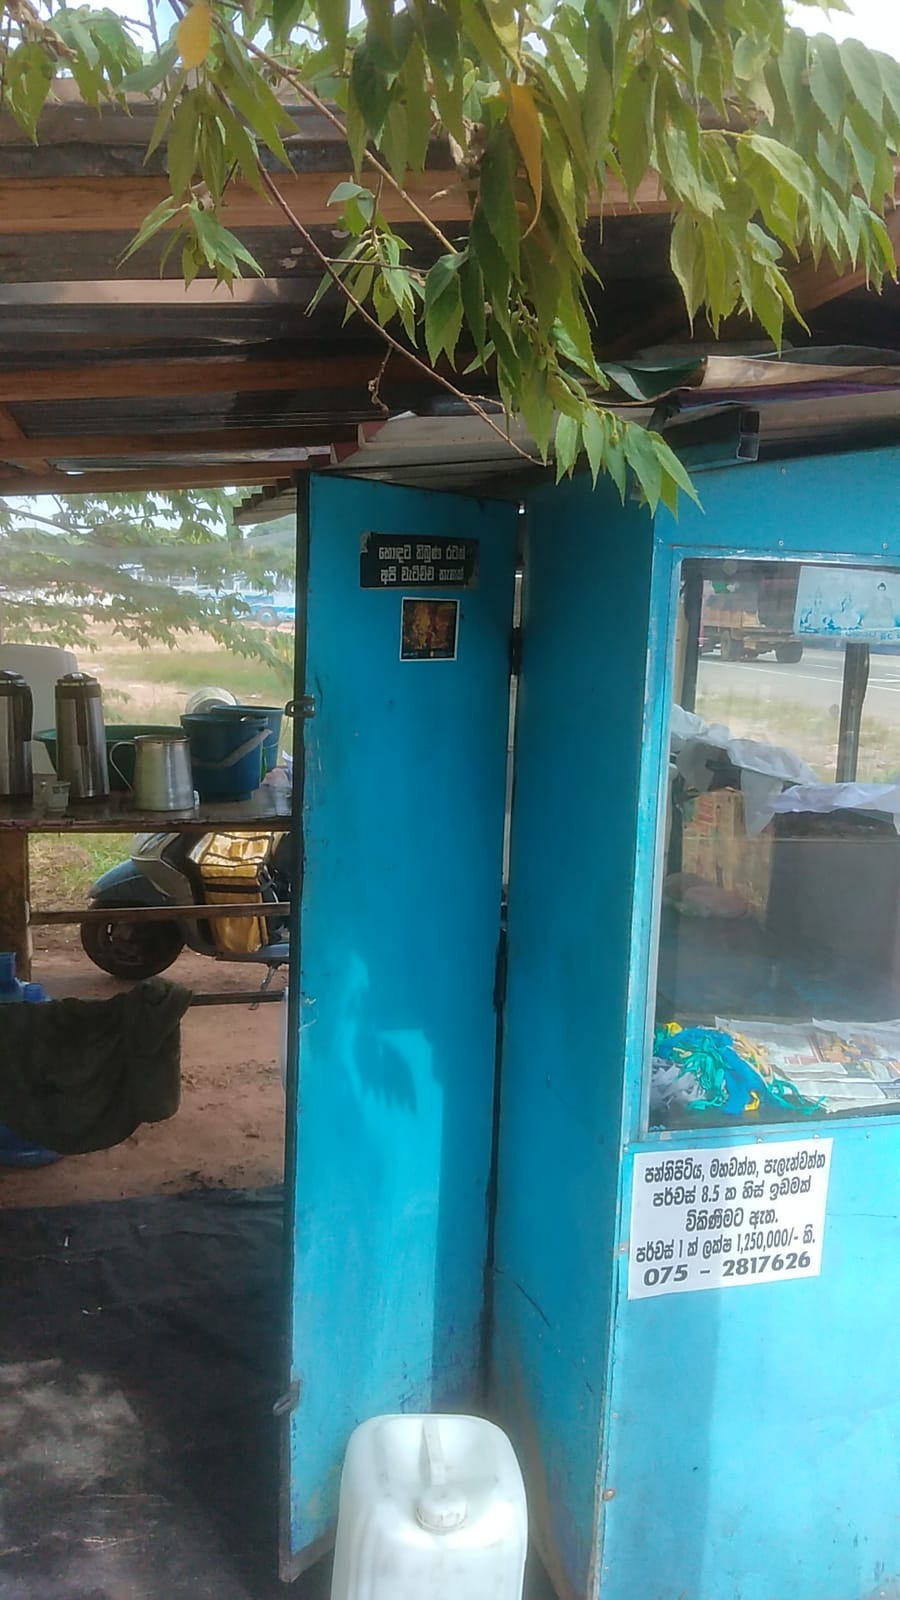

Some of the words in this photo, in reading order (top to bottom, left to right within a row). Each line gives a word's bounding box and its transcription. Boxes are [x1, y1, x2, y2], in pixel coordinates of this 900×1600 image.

[380, 566, 397, 585] අපි
[645, 1157, 705, 1183] පන්නිපිටිය,
[709, 1156, 759, 1178] මහවත්ත,
[764, 1150, 826, 1177] පැලැන්වත්ත
[653, 1185, 697, 1207] පර්චස්
[701, 1184, 720, 1203] 8.5
[725, 1186, 737, 1201] ක
[742, 1180, 765, 1199] හිස්
[769, 1175, 812, 1201] ඉඩමක්
[685, 1207, 744, 1232] විකිණීමට
[749, 1209, 778, 1230] ඇත.
[636, 1239, 674, 1263] පර්චස්
[679, 1239, 683, 1258] 1
[687, 1236, 698, 1257] ක්
[702, 1234, 732, 1259] ලක්ෂ
[737, 1227, 799, 1254] 1,250,000/-
[803, 1224, 815, 1244] කි.
[644, 1264, 688, 1286] 075
[722, 1251, 811, 1277] 2817626
